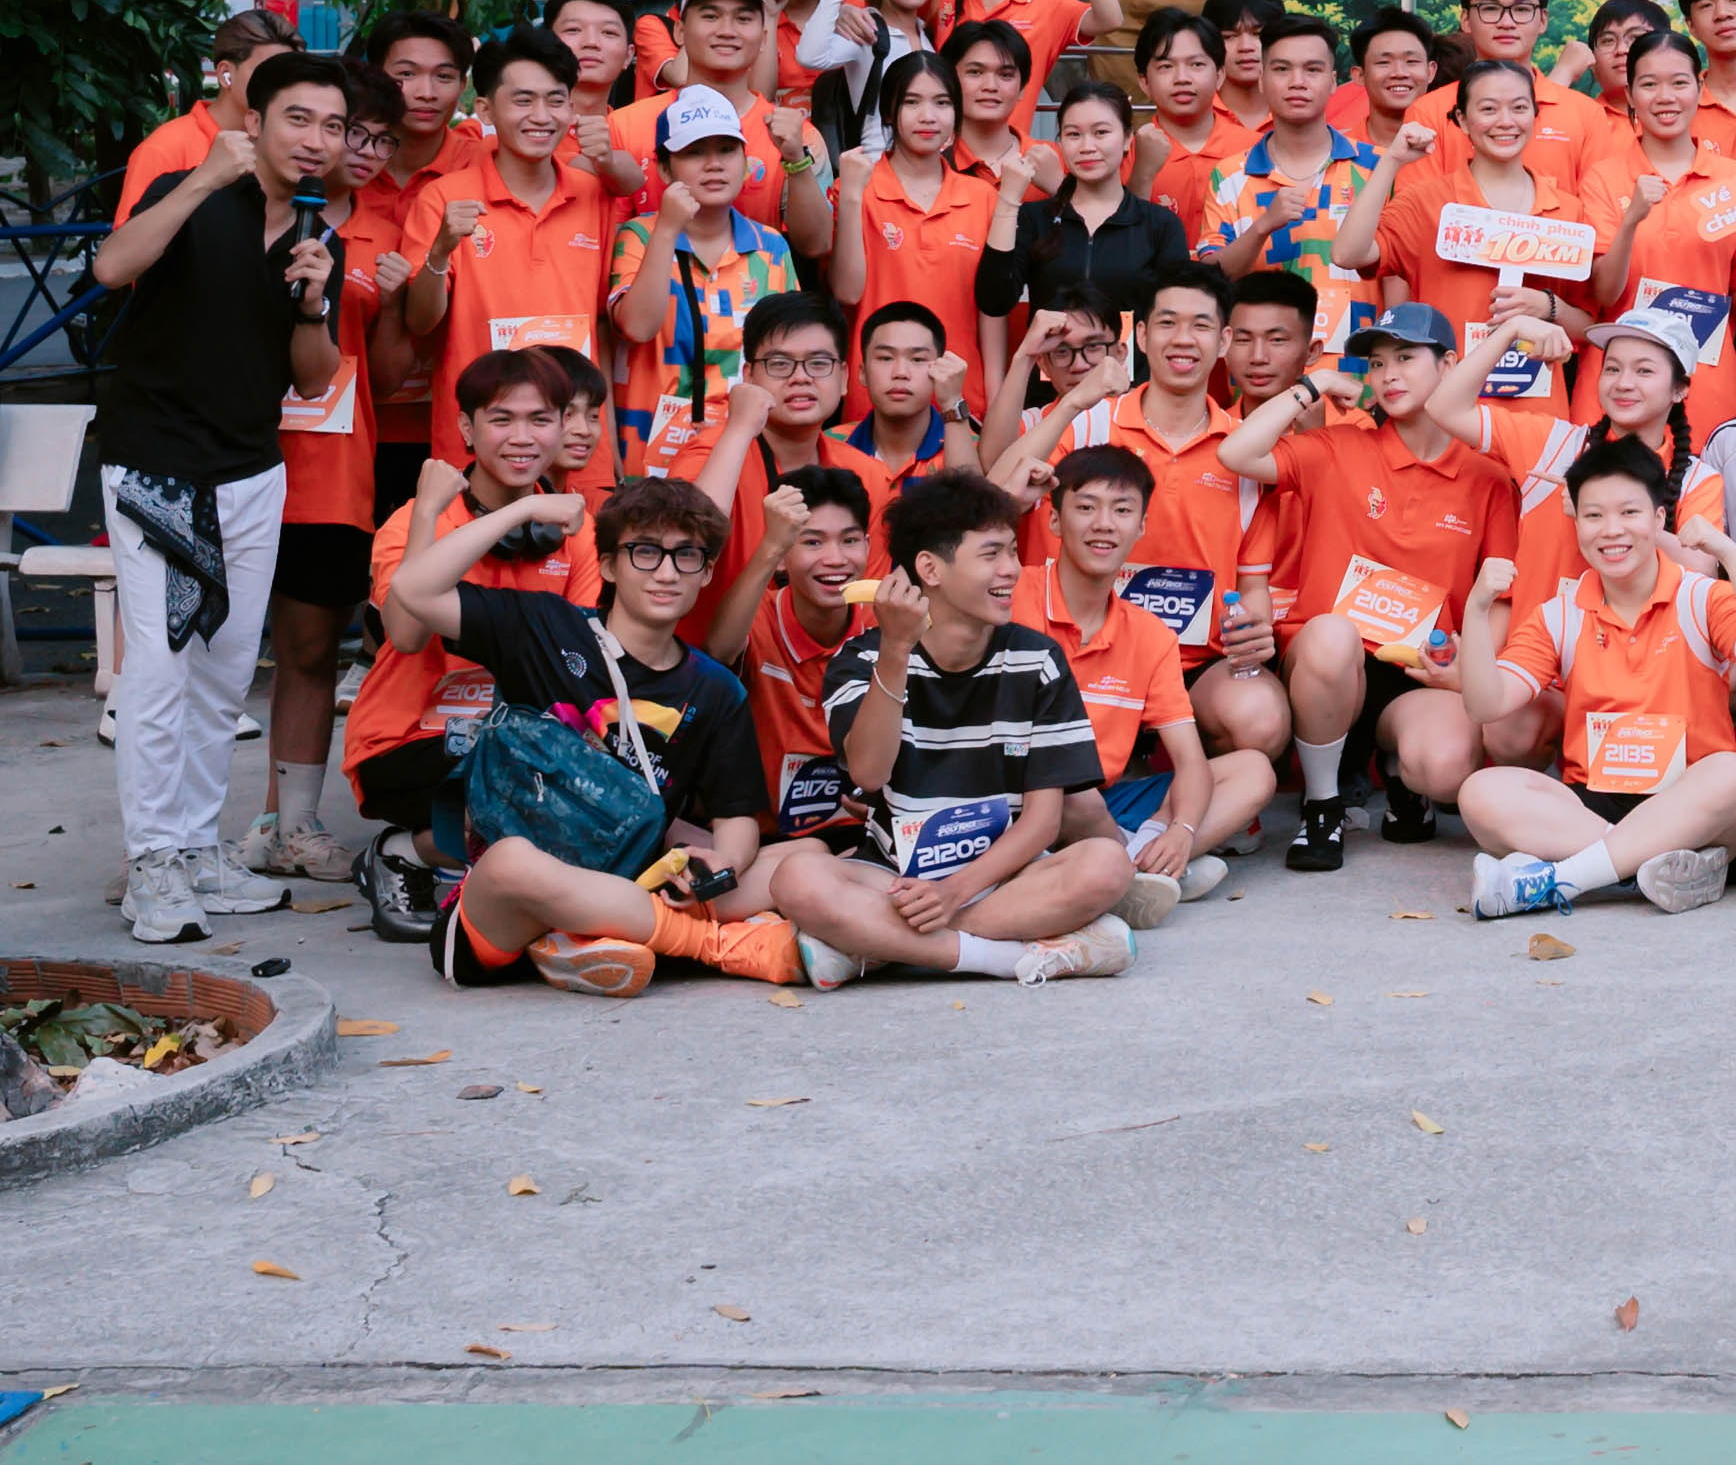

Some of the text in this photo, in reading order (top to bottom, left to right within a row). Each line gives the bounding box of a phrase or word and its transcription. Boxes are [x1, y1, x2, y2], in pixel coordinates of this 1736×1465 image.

[1487, 231, 1580, 265] 10KM
[1354, 588, 1420, 624] 21034
[791, 779, 842, 800] 21176
[917, 835, 991, 869] 21209
